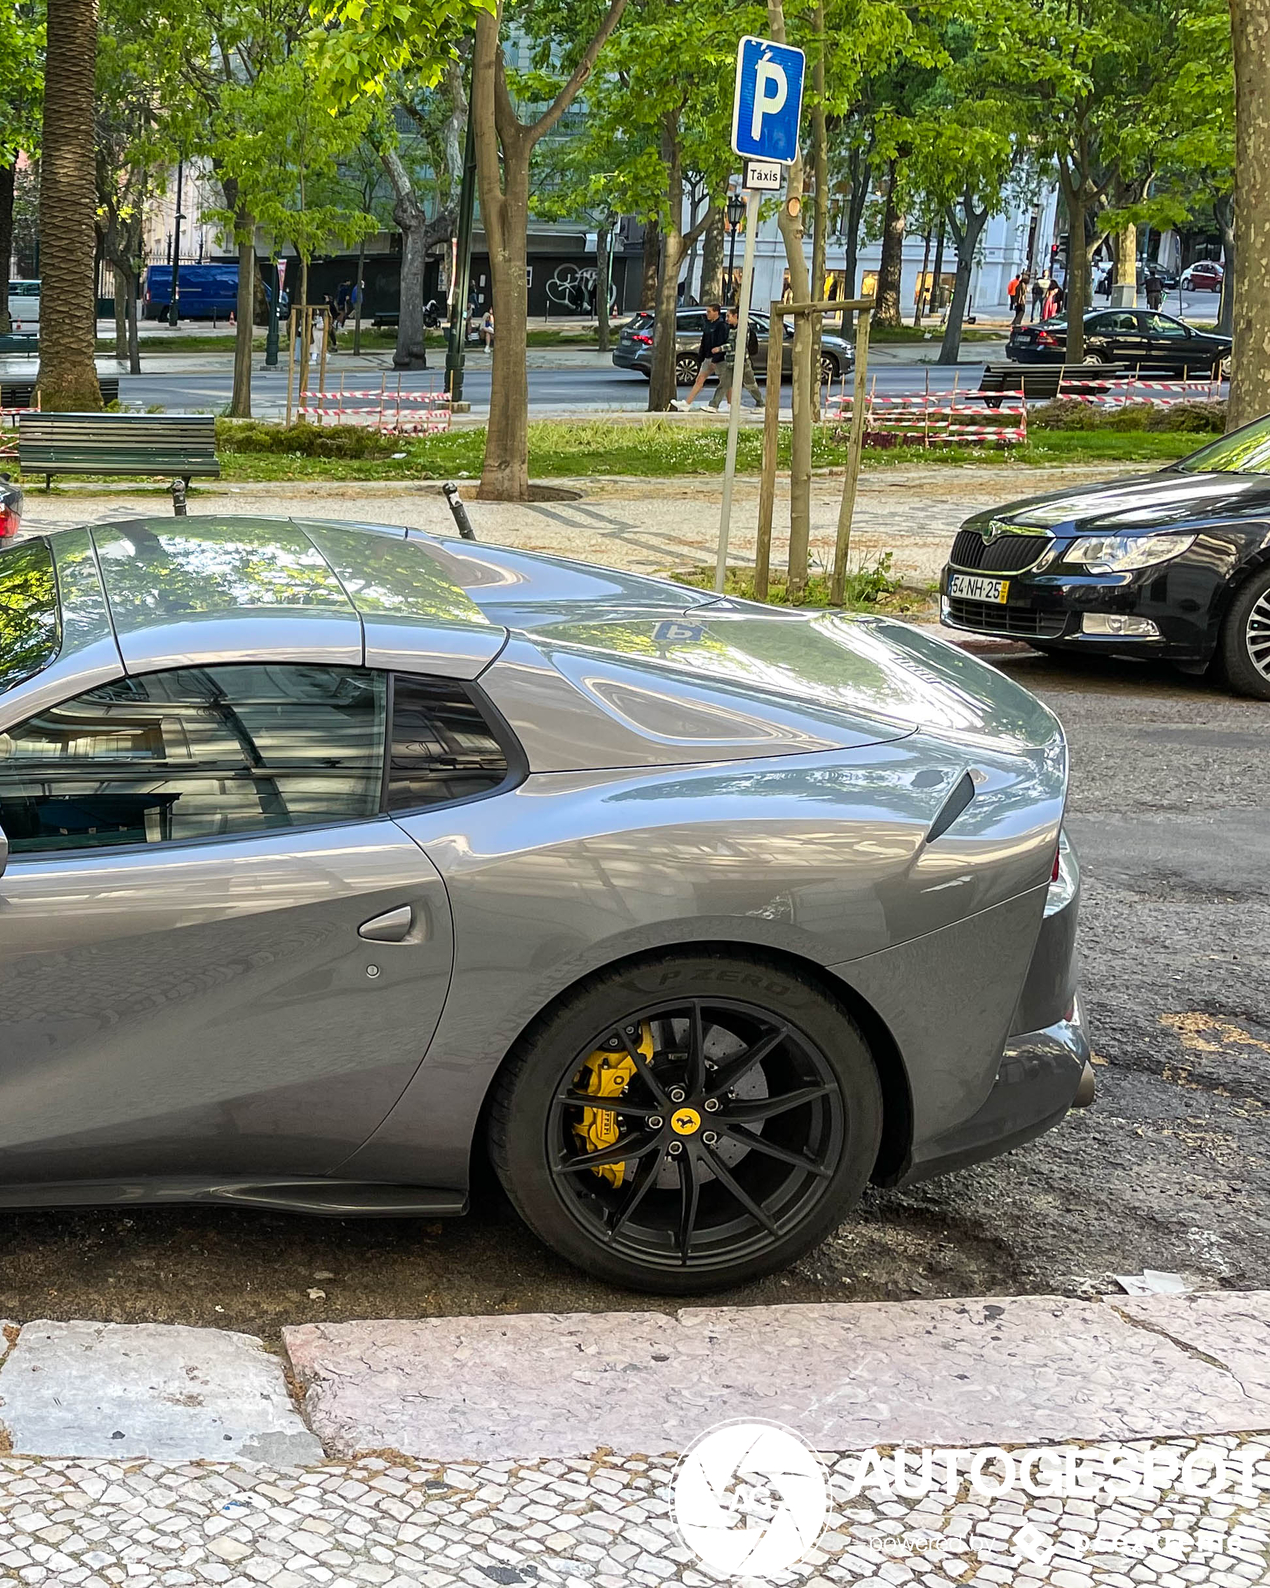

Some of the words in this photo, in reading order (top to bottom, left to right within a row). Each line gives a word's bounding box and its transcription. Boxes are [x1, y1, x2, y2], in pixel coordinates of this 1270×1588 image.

[751, 60, 788, 141] P
[750, 169, 778, 182] Táxis
[659, 971, 681, 986] P
[690, 969, 791, 996] ZERO
